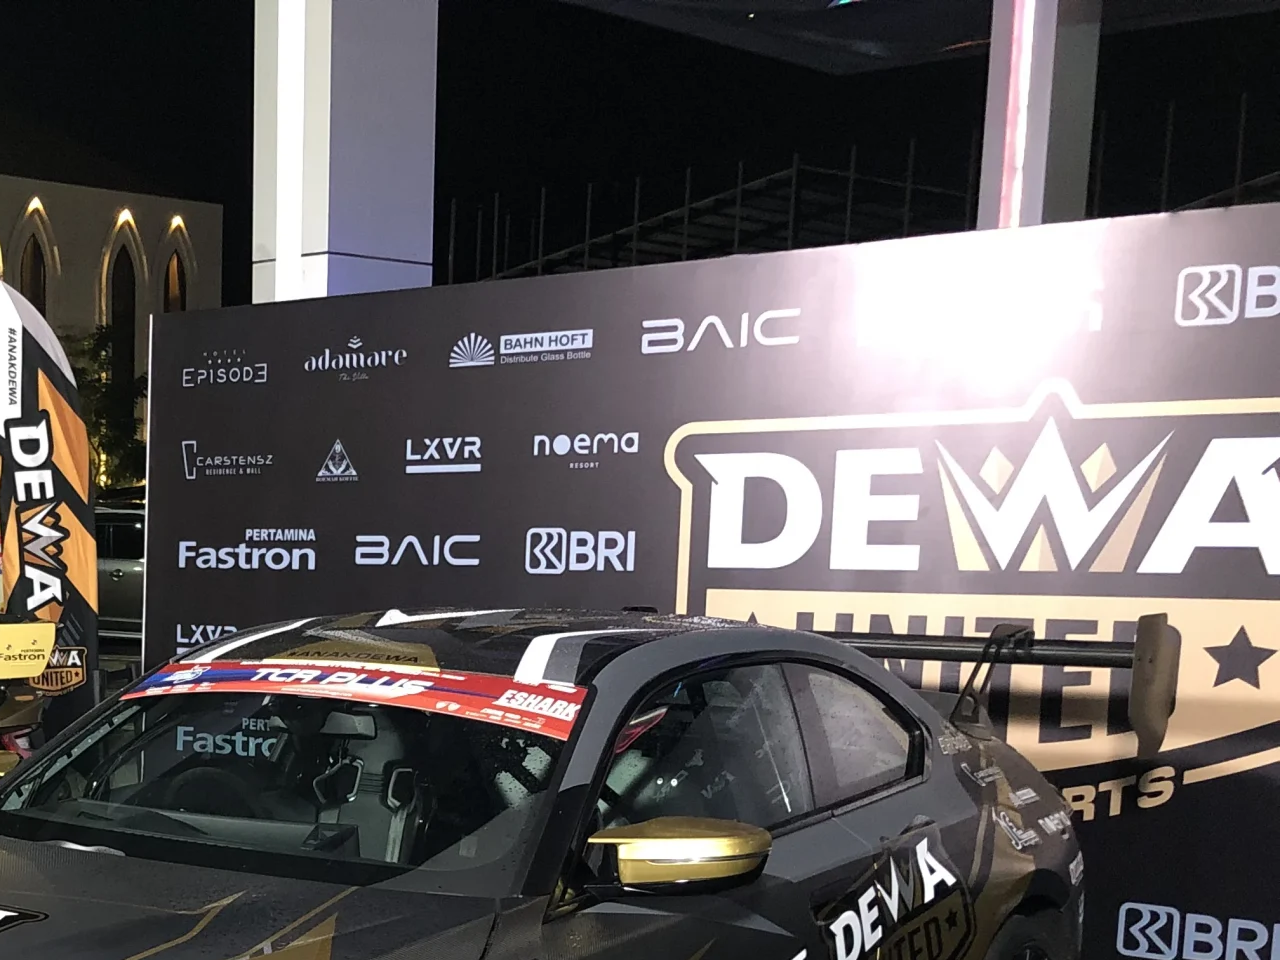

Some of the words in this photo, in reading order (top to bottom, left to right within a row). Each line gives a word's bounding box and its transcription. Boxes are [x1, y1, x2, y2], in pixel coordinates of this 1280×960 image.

[504, 335, 544, 350] BAHN
[548, 333, 589, 348] HOFT
[641, 308, 801, 354] BAIC
[8, 327, 18, 406] #ANAKDEWA
[304, 348, 408, 372] adamare
[500, 353, 539, 364] Distribute
[541, 352, 565, 362] Glass
[567, 351, 591, 361] Bottle
[182, 363, 268, 387] EPISODE
[406, 436, 482, 460] LXVR
[533, 432, 639, 456] noema
[196, 455, 273, 467] CARSTENSZ
[694, 416, 1280, 575] DEWA
[9, 419, 65, 612] DEWA
[245, 528, 316, 542] PERTAMINA
[178, 541, 316, 571] Fastron
[355, 534, 481, 566] BAIC
[569, 530, 636, 572] BRI
[250, 667, 322, 684] TCR
[319, 671, 435, 693] PLUS
[496, 689, 582, 722] ESHARK
